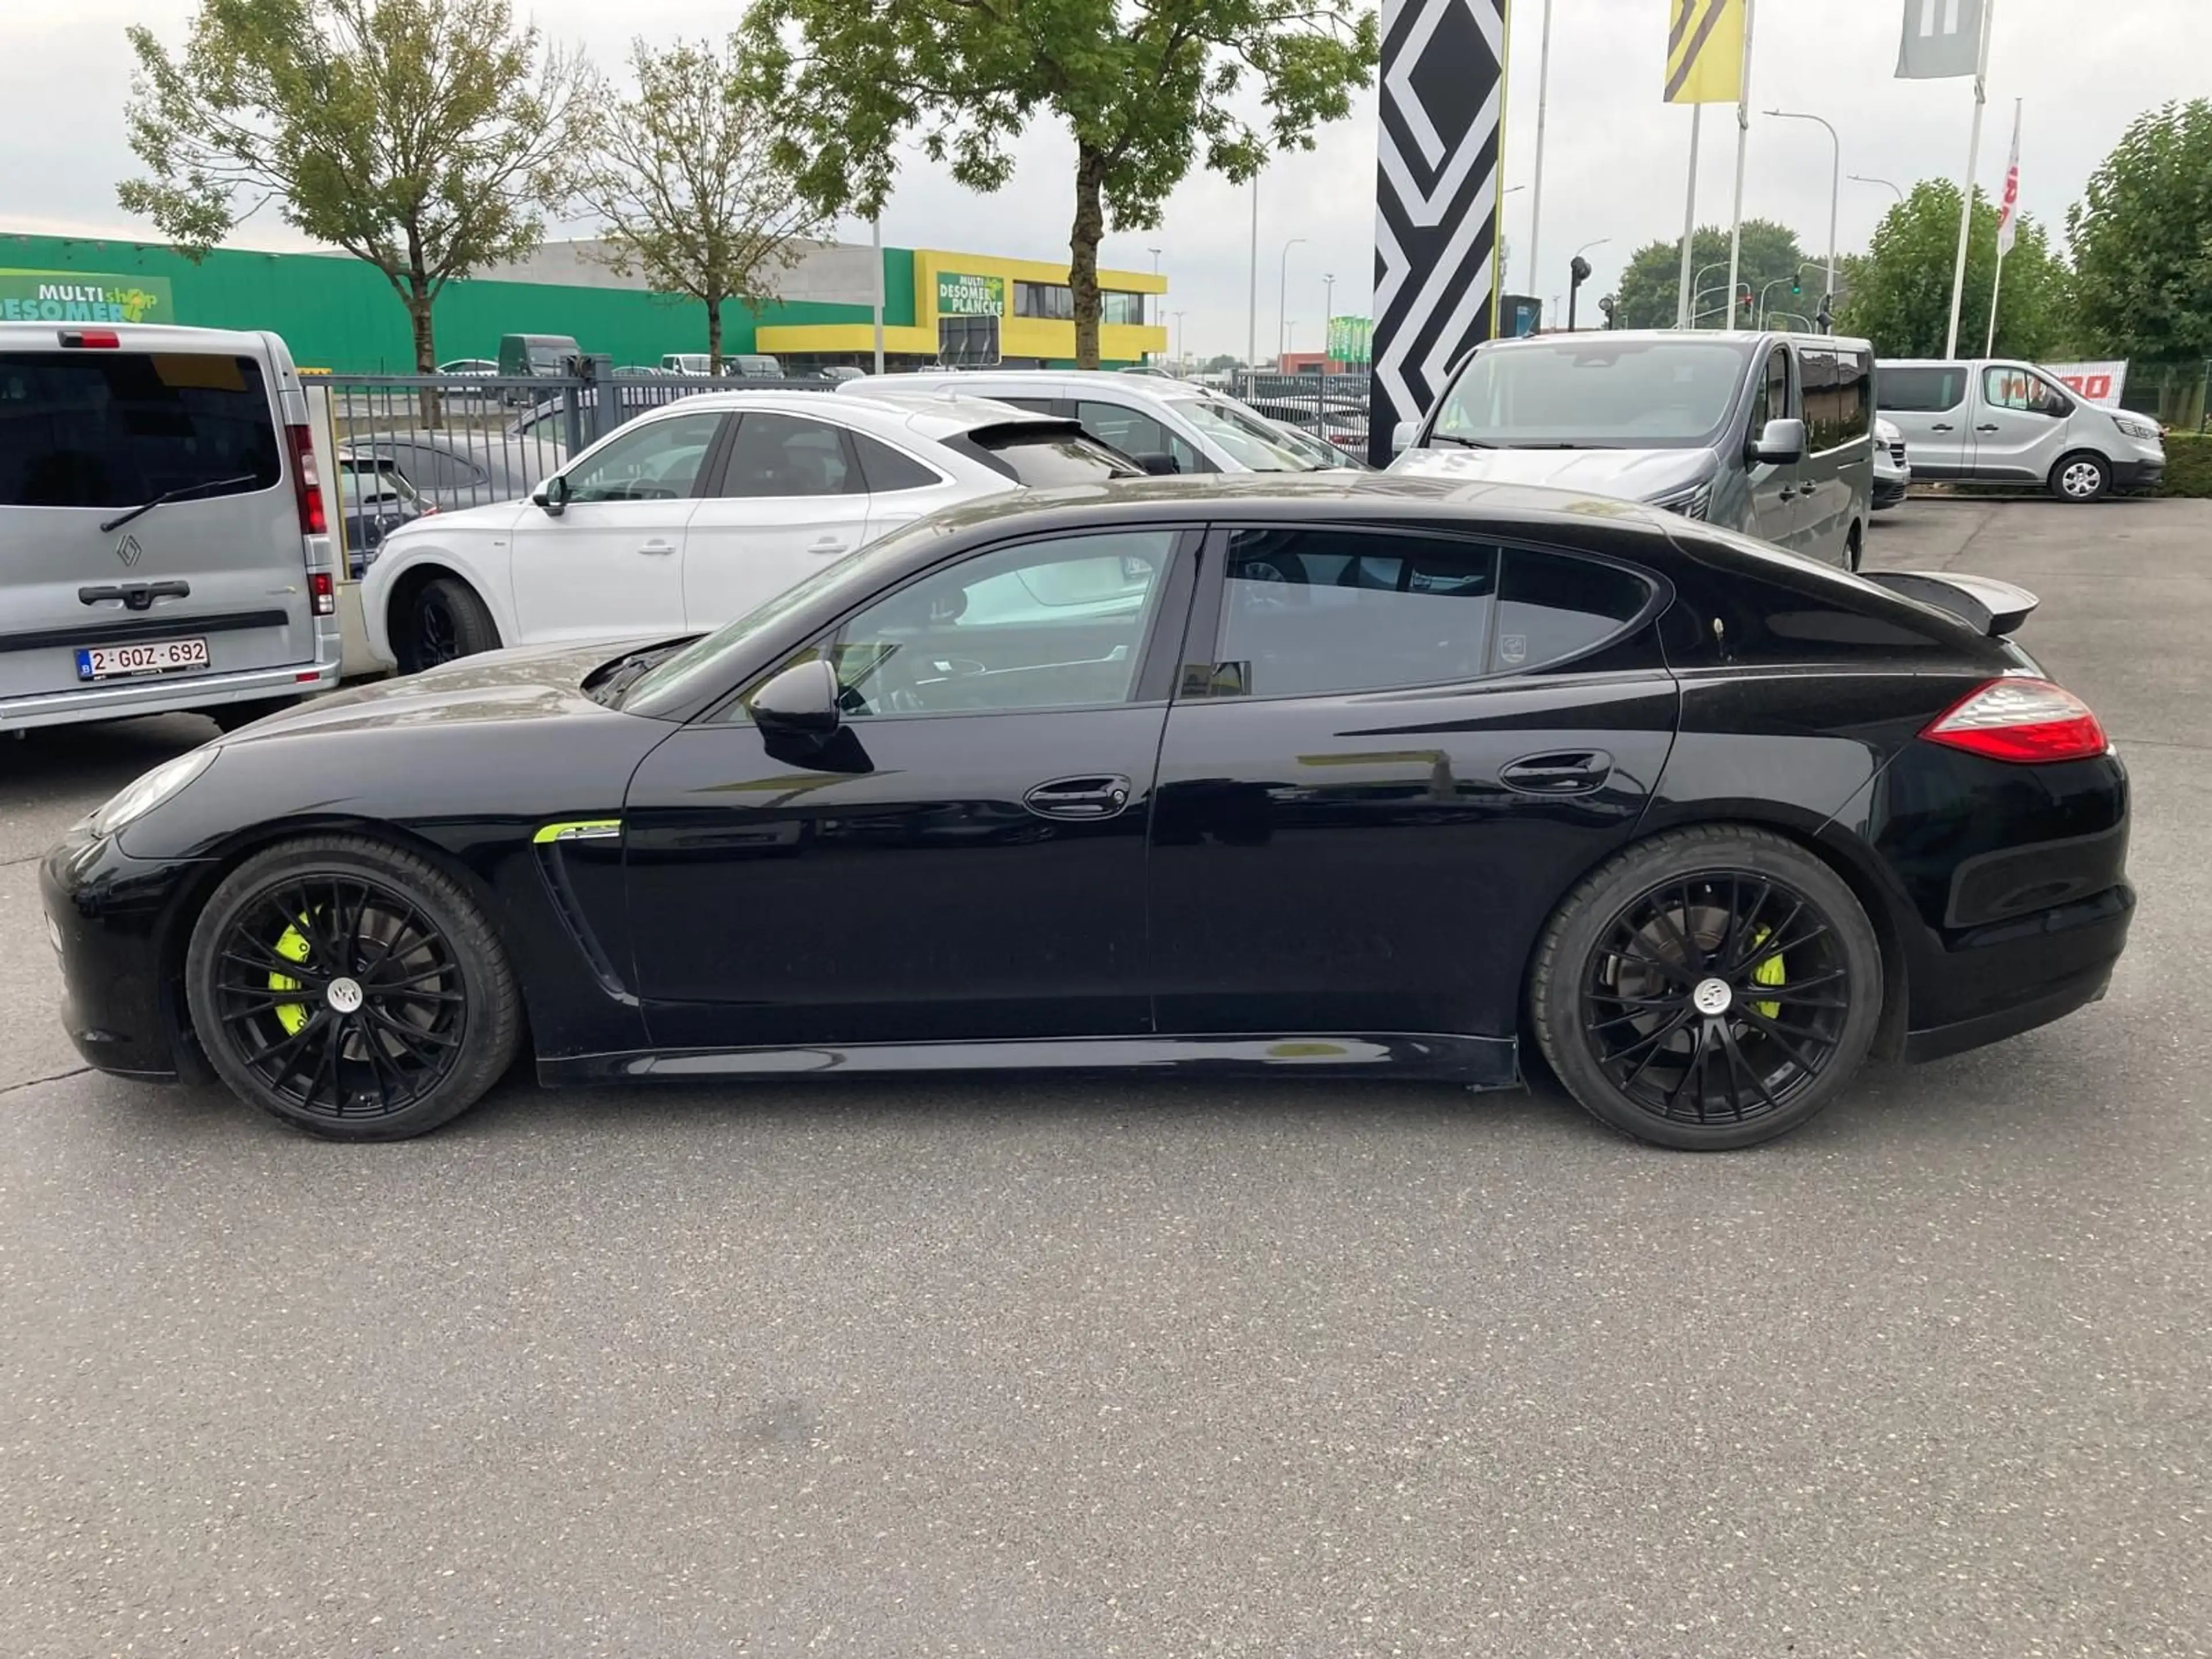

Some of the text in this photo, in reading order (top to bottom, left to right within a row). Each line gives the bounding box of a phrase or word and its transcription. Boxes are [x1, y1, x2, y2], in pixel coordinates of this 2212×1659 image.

[959, 276, 984, 286] MULTI
[39, 284, 103, 302] MULTI
[0, 298, 123, 322] ESOMER
[952, 298, 1003, 316] PLANCKE
